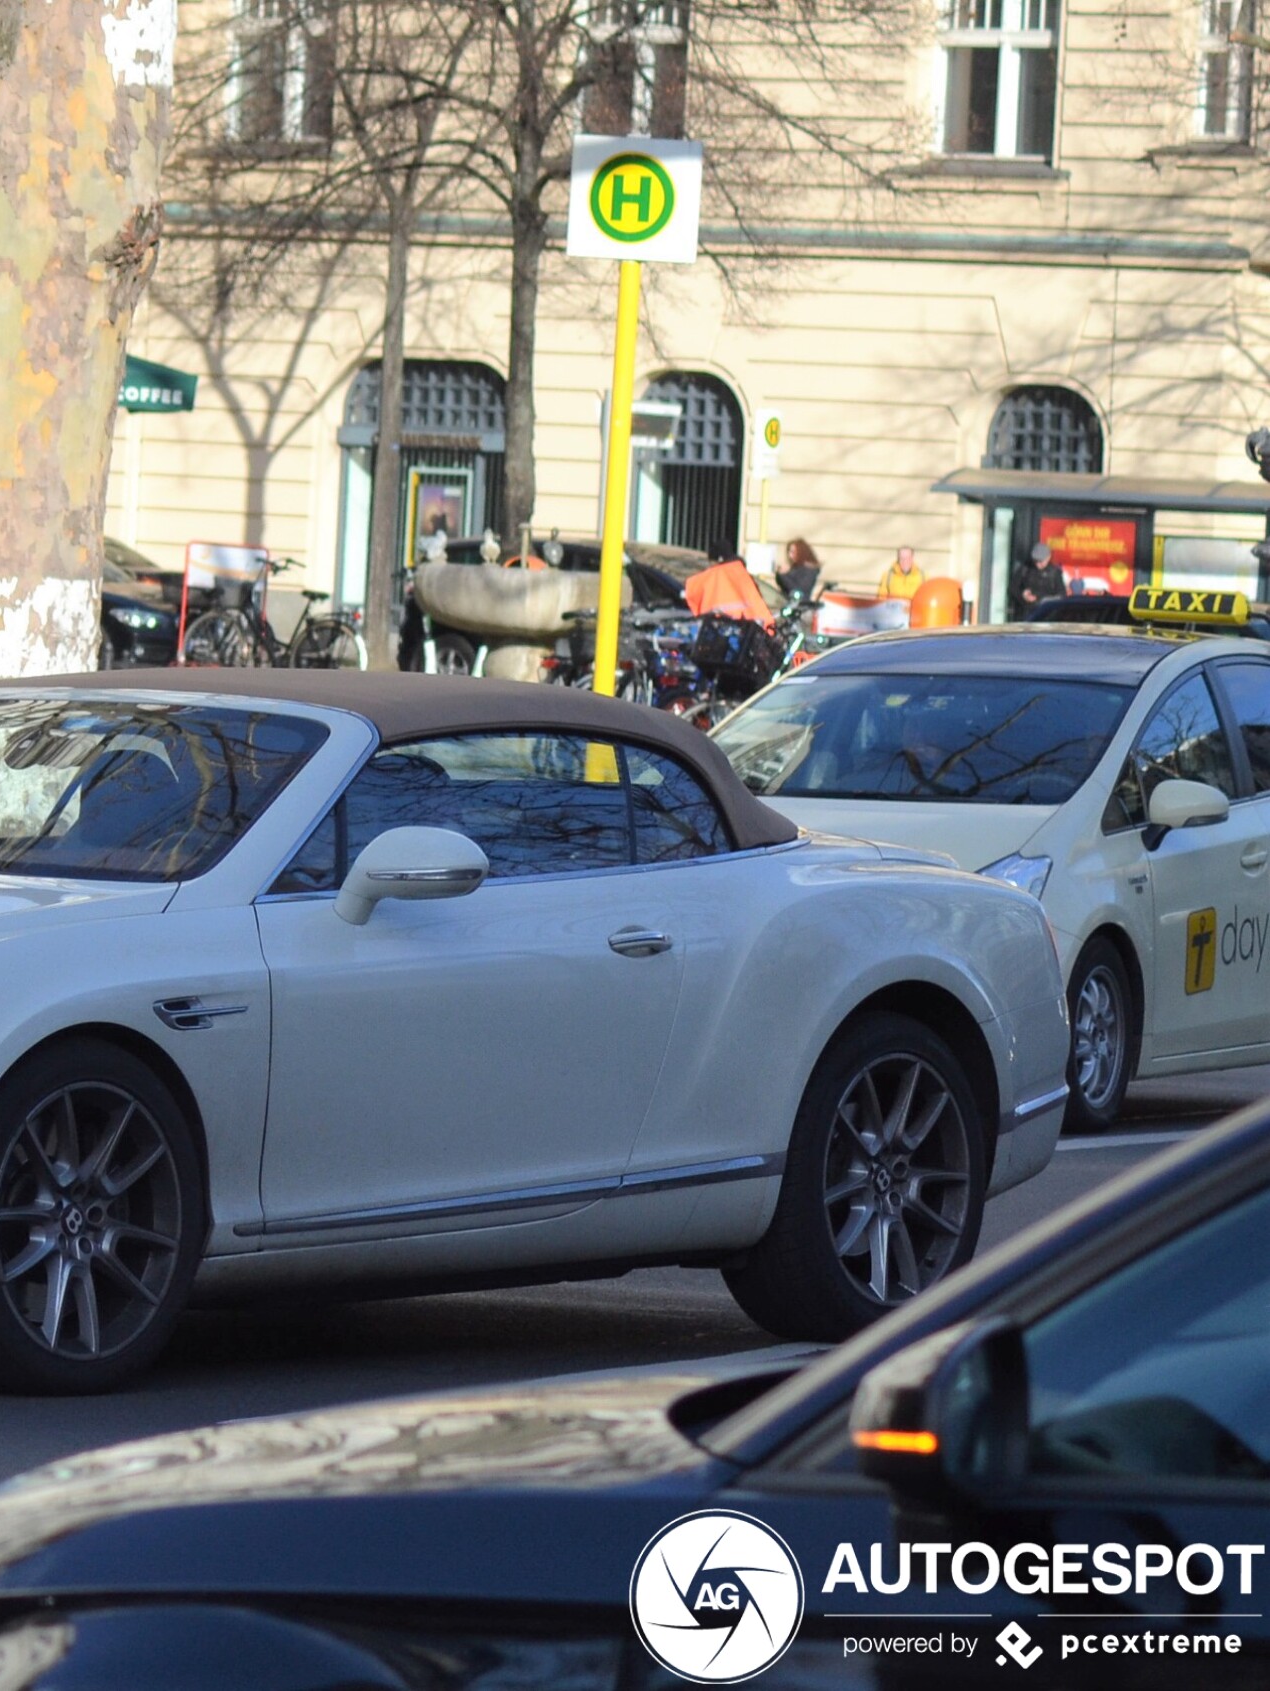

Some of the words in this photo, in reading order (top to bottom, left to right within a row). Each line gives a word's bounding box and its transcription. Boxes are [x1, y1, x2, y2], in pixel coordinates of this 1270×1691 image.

[610, 174, 651, 223] H
[1147, 590, 1222, 613] TAXI
[1221, 904, 1270, 973] day
